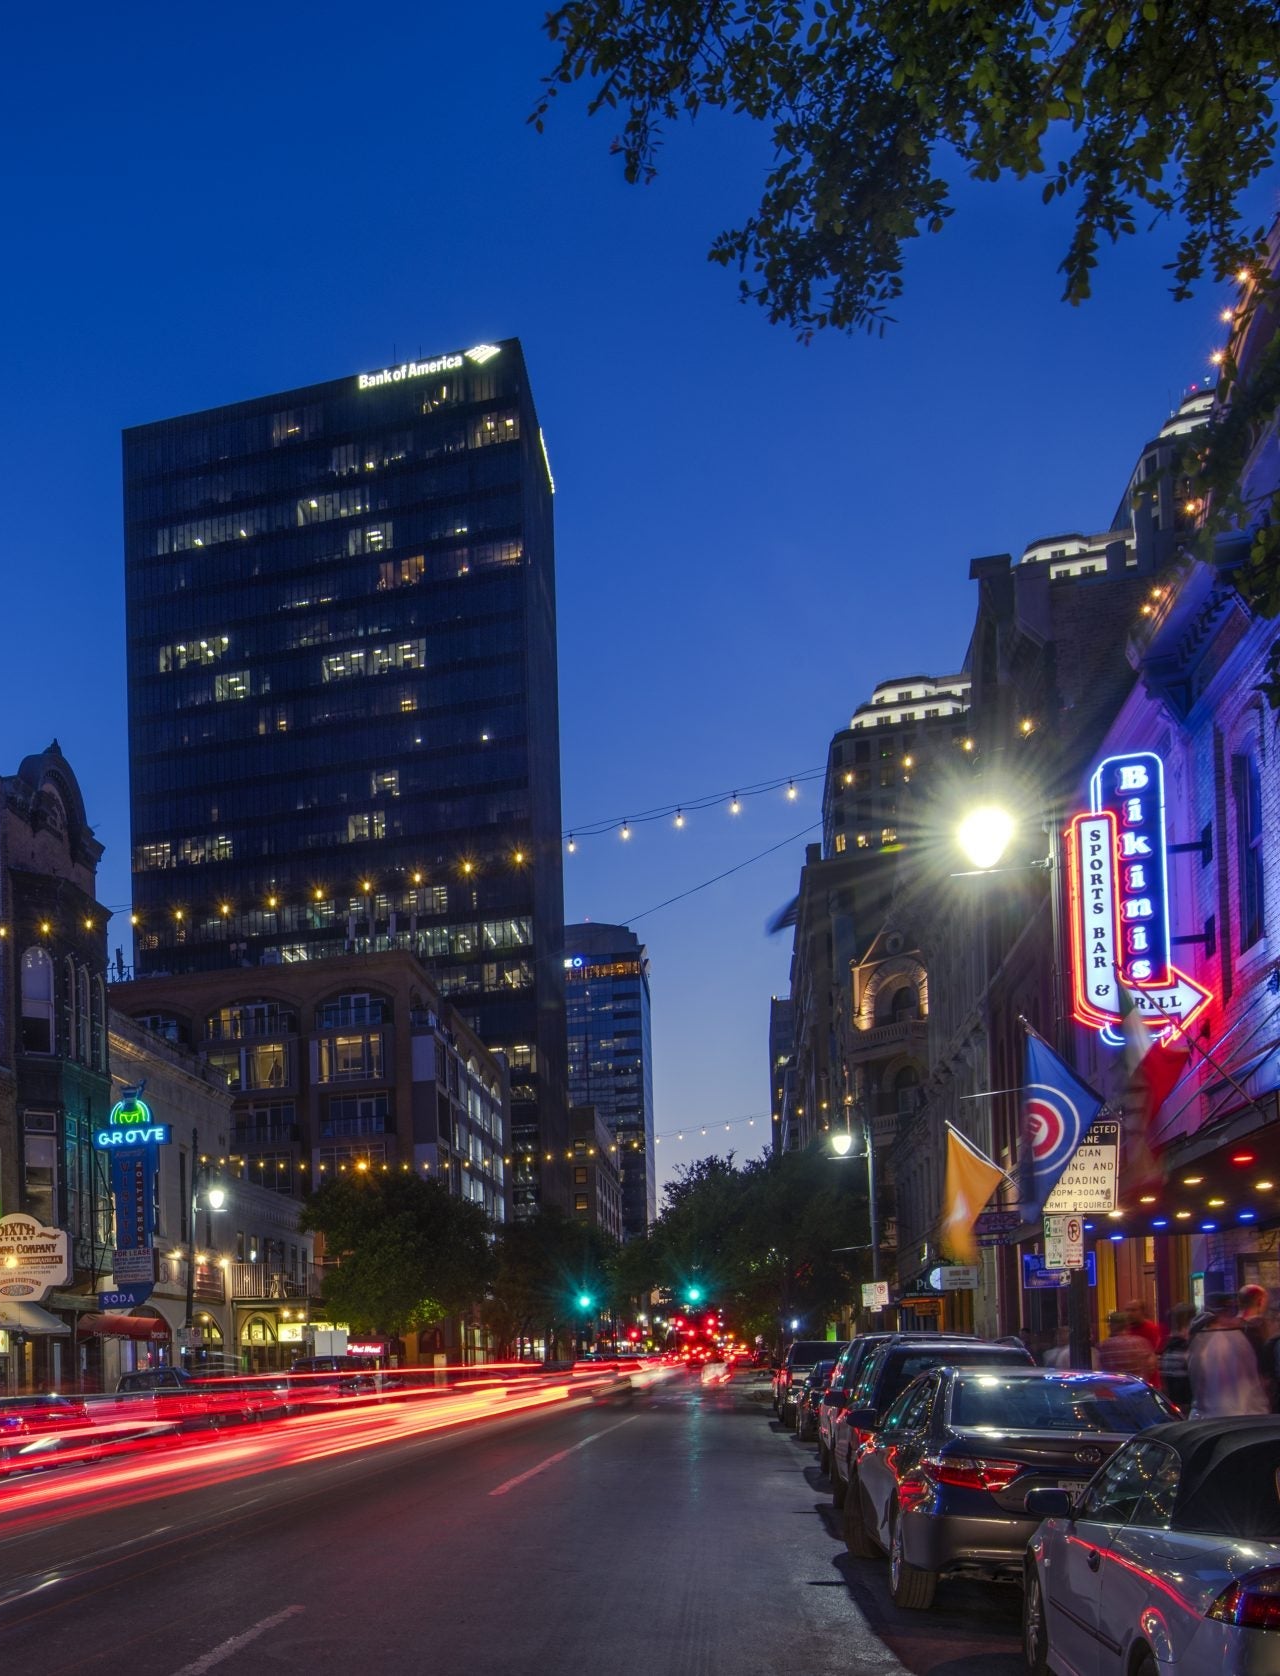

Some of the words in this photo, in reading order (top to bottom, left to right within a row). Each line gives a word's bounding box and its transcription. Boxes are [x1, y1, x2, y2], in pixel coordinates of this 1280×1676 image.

[359, 369, 392, 390] Bank
[393, 364, 407, 381] of
[408, 355, 463, 378] America
[1089, 829, 1104, 915] SPORTS
[1116, 764, 1154, 981] Bikinis
[1093, 927, 1108, 969] BAR
[1095, 984, 1110, 997] &
[1133, 989, 1182, 1010] RILL
[1089, 1125, 1117, 1134] ICTED
[98, 1128, 164, 1146] GROVE
[1081, 1136, 1100, 1144] ANE
[1093, 1162, 1114, 1171] AND
[1057, 1176, 1106, 1185] LOADING
[120, 1161, 132, 1246] VISITO
[1073, 1201, 1113, 1209] REQUIRED
[16, 1243, 57, 1255] COMPANY
[103, 1293, 135, 1304] SODA
